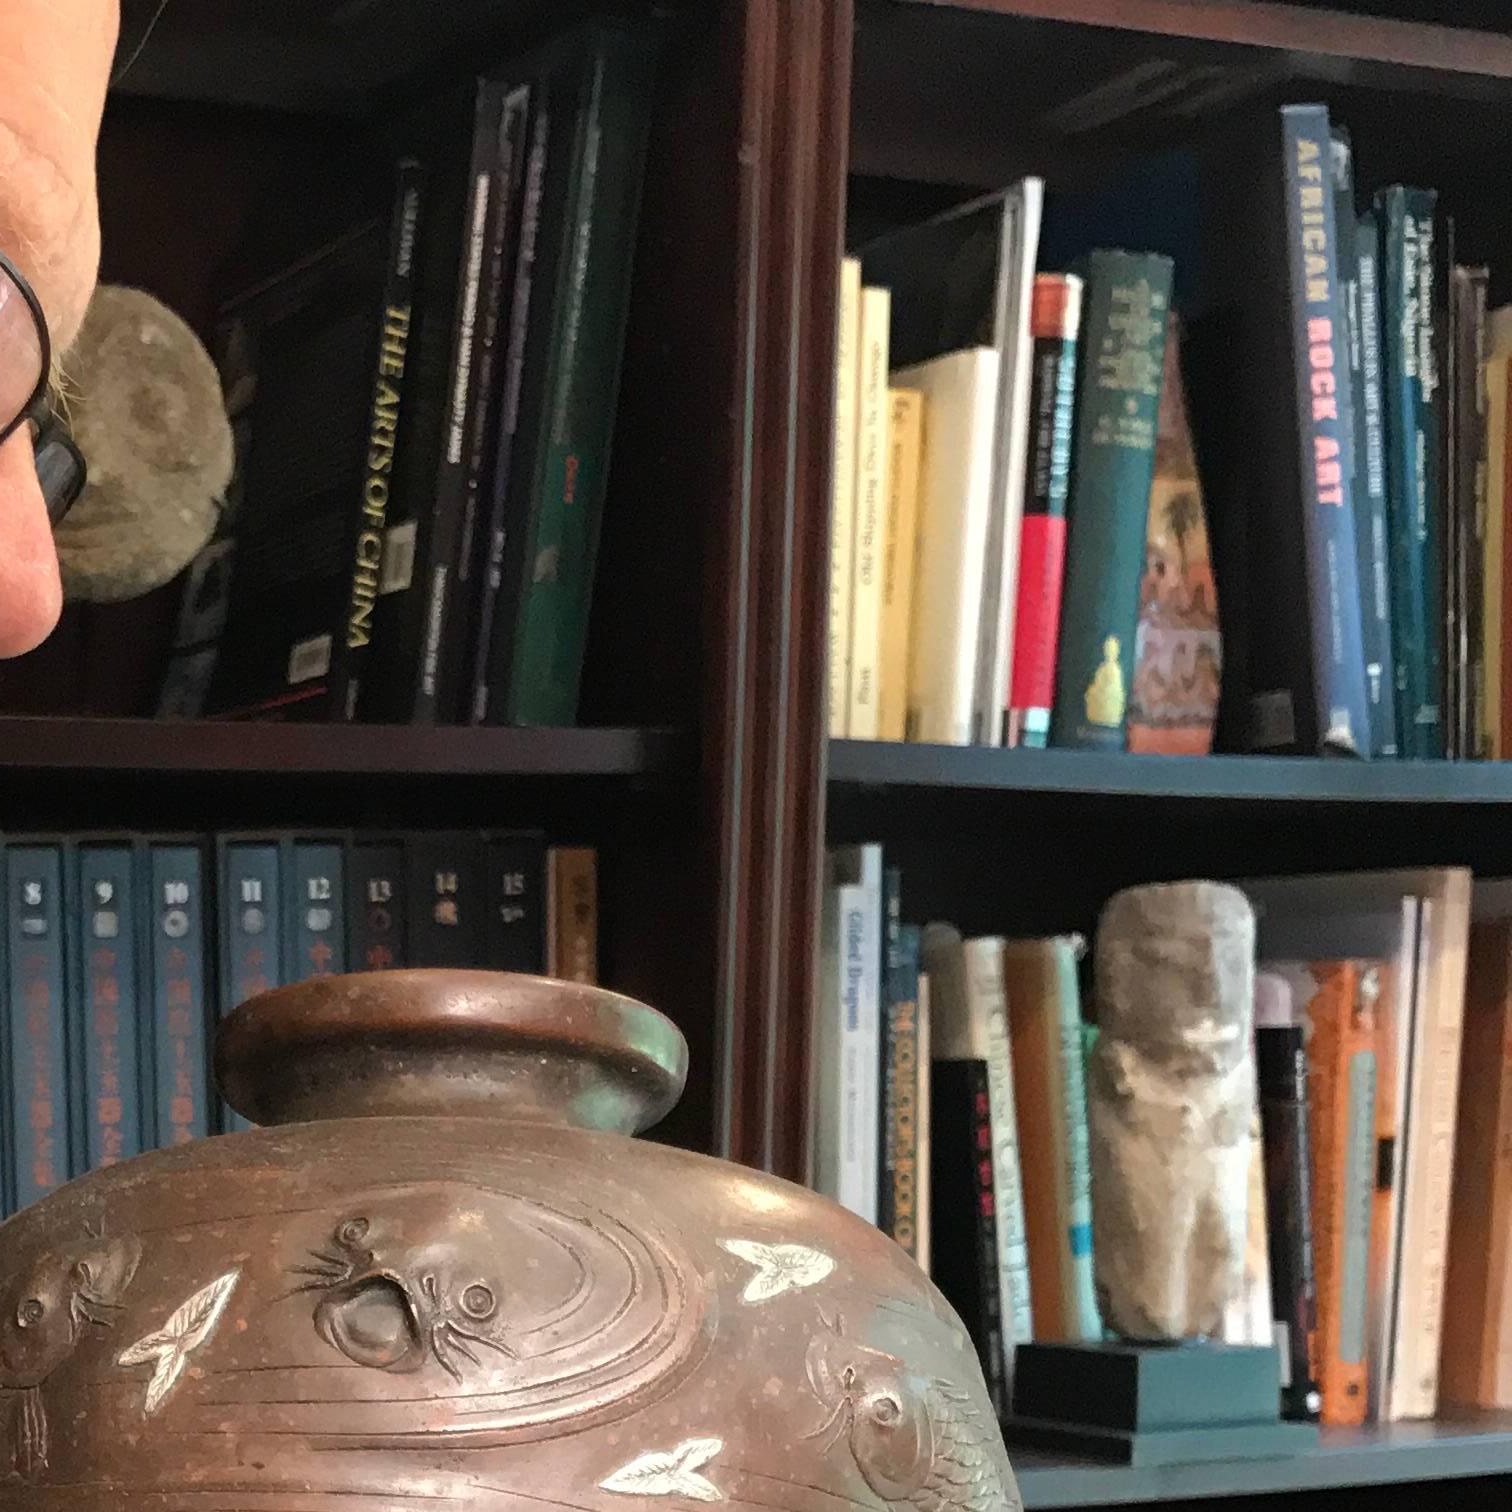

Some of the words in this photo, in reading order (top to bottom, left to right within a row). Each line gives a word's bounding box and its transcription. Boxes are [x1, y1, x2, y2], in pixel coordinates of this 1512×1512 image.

[1295, 138, 1330, 303] AFRICAN
[380, 304, 411, 377] THE
[1307, 316, 1337, 422] ROCK
[371, 379, 404, 472] ARTS
[363, 476, 390, 526] OF
[1313, 435, 1343, 508] ART
[346, 530, 384, 650] CHINA
[23, 881, 42, 905] 8
[94, 879, 113, 905] 9
[241, 879, 262, 902] 11
[307, 877, 331, 900] 12
